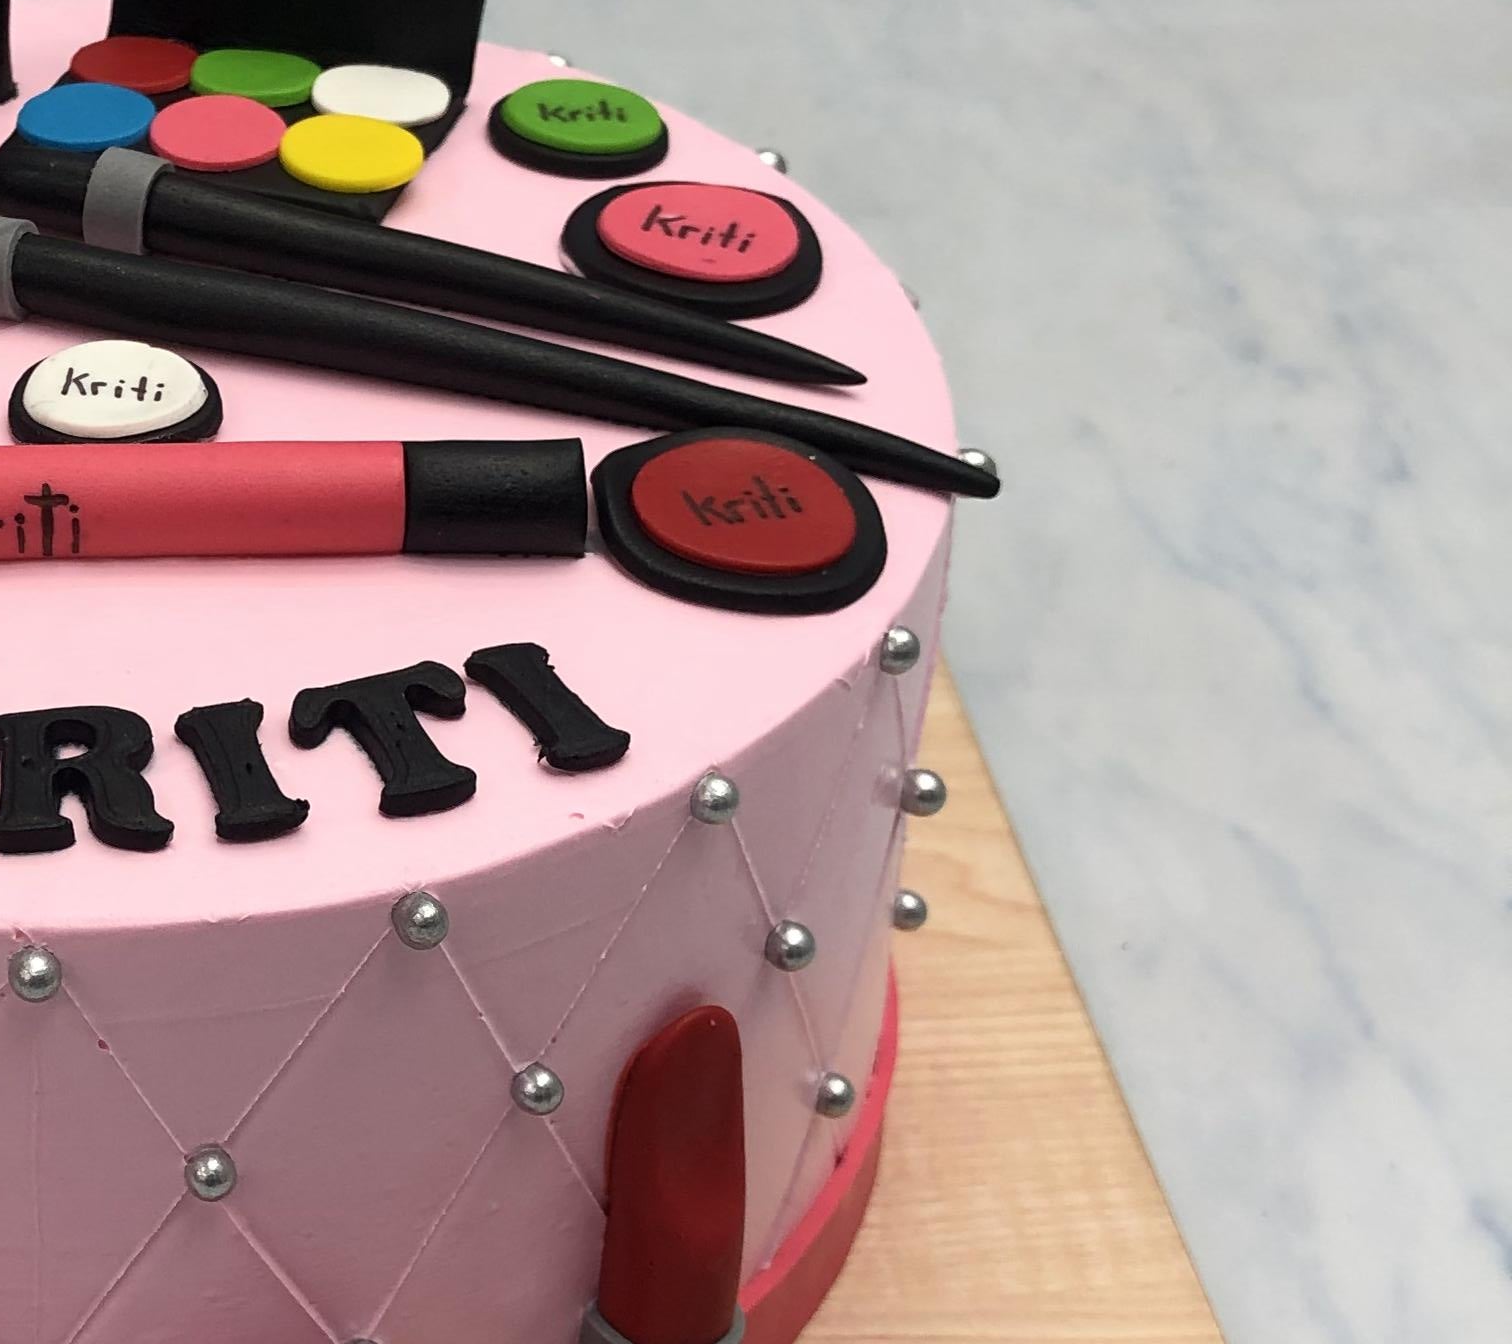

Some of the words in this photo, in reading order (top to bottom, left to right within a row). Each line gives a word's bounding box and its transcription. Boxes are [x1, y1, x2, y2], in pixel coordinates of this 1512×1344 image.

[537, 98, 630, 129] Kriti
[641, 204, 756, 256] Kriti
[60, 367, 166, 403] Kriti
[682, 475, 808, 527] Kriti
